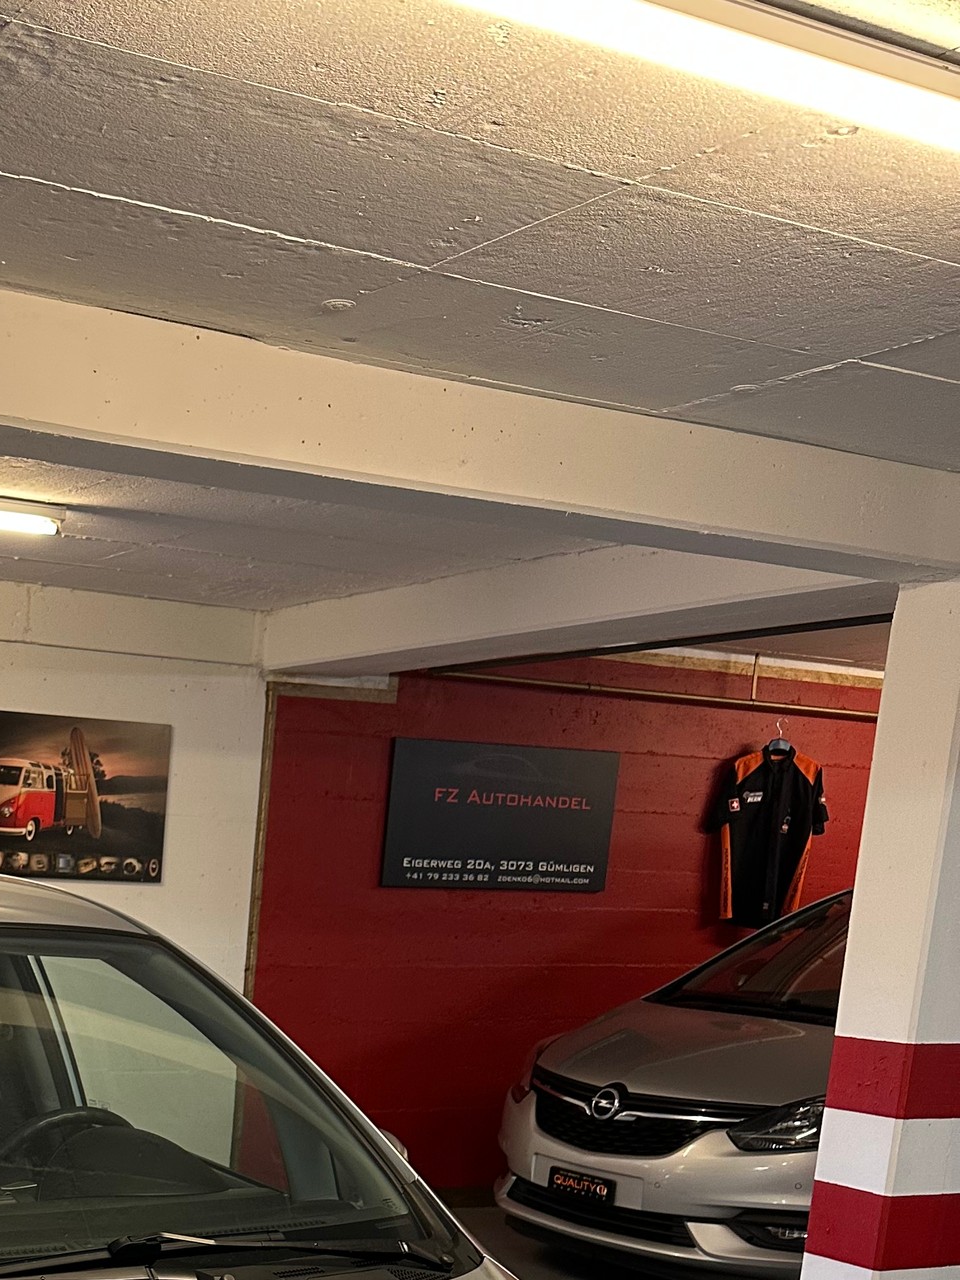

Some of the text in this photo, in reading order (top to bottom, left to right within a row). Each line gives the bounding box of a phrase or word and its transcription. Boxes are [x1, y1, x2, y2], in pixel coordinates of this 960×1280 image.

[434, 788, 591, 810] FZ AUTOHANDEL
[402, 857, 462, 869] EIGERWEG
[500, 860, 534, 871] 3073
[538, 860, 594, 873] GÜMLIGEN
[442, 873, 460, 881] 233
[553, 1174, 597, 1192] QUALITY
